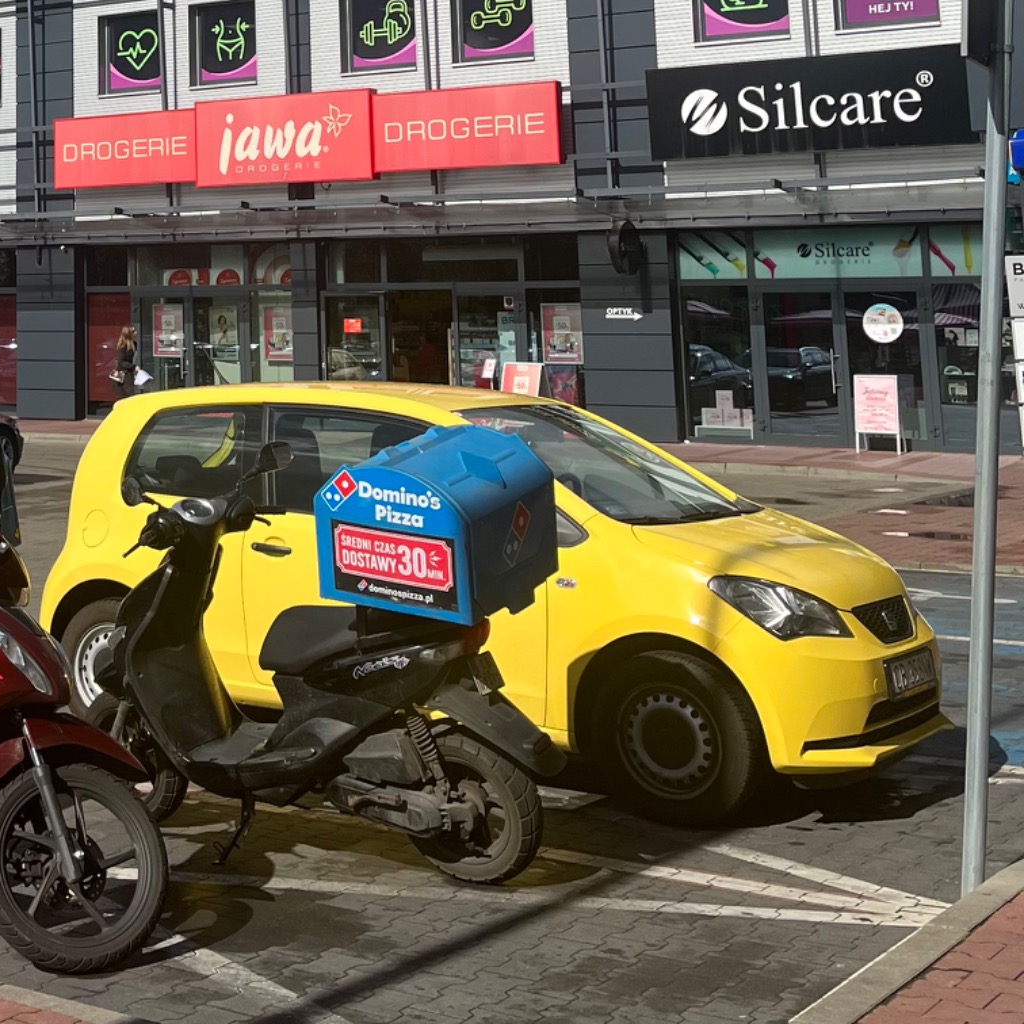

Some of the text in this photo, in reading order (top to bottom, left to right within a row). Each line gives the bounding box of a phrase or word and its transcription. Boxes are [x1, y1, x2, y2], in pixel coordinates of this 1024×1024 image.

[868, 0, 914, 14] HEJ TY!
[385, 112, 545, 143] DROGERIE
[63, 136, 188, 163] DROGERIE
[219, 113, 323, 176] jawa
[235, 160, 321, 174] DROGERIE
[606, 306, 633, 315] OPTYK
[358, 480, 441, 510] Domino's
[375, 504, 424, 527] Pizza
[341, 533, 396, 555] ŚREDNI CZAS
[342, 549, 397, 574] DOSTAWY
[397, 545, 428, 579] 30
[368, 583, 434, 603] dominospizza.pl
